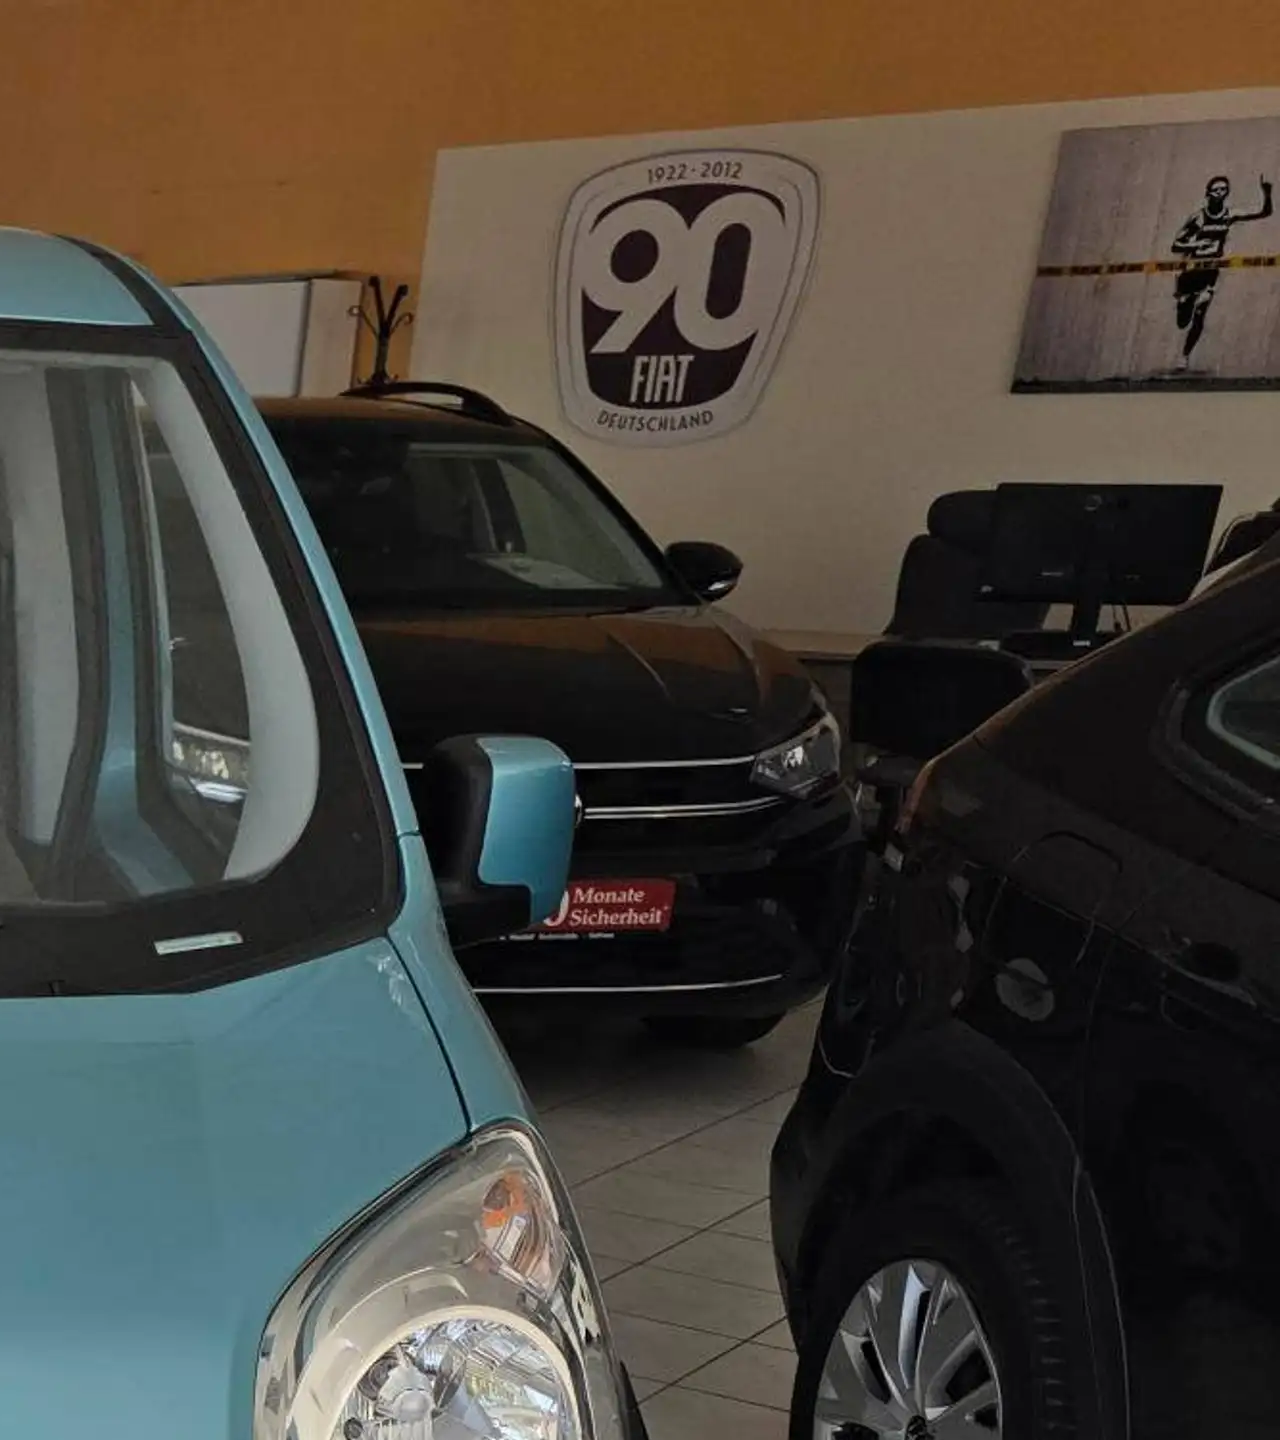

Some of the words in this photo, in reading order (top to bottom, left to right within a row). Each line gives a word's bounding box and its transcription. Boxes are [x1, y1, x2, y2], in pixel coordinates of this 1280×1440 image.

[647, 162, 688, 184] 1922
[700, 160, 743, 180] 2012
[582, 191, 787, 355] 90
[630, 354, 696, 404] FIAT
[596, 409, 714, 432] DEUTSCHLAND
[573, 886, 646, 904] Monate
